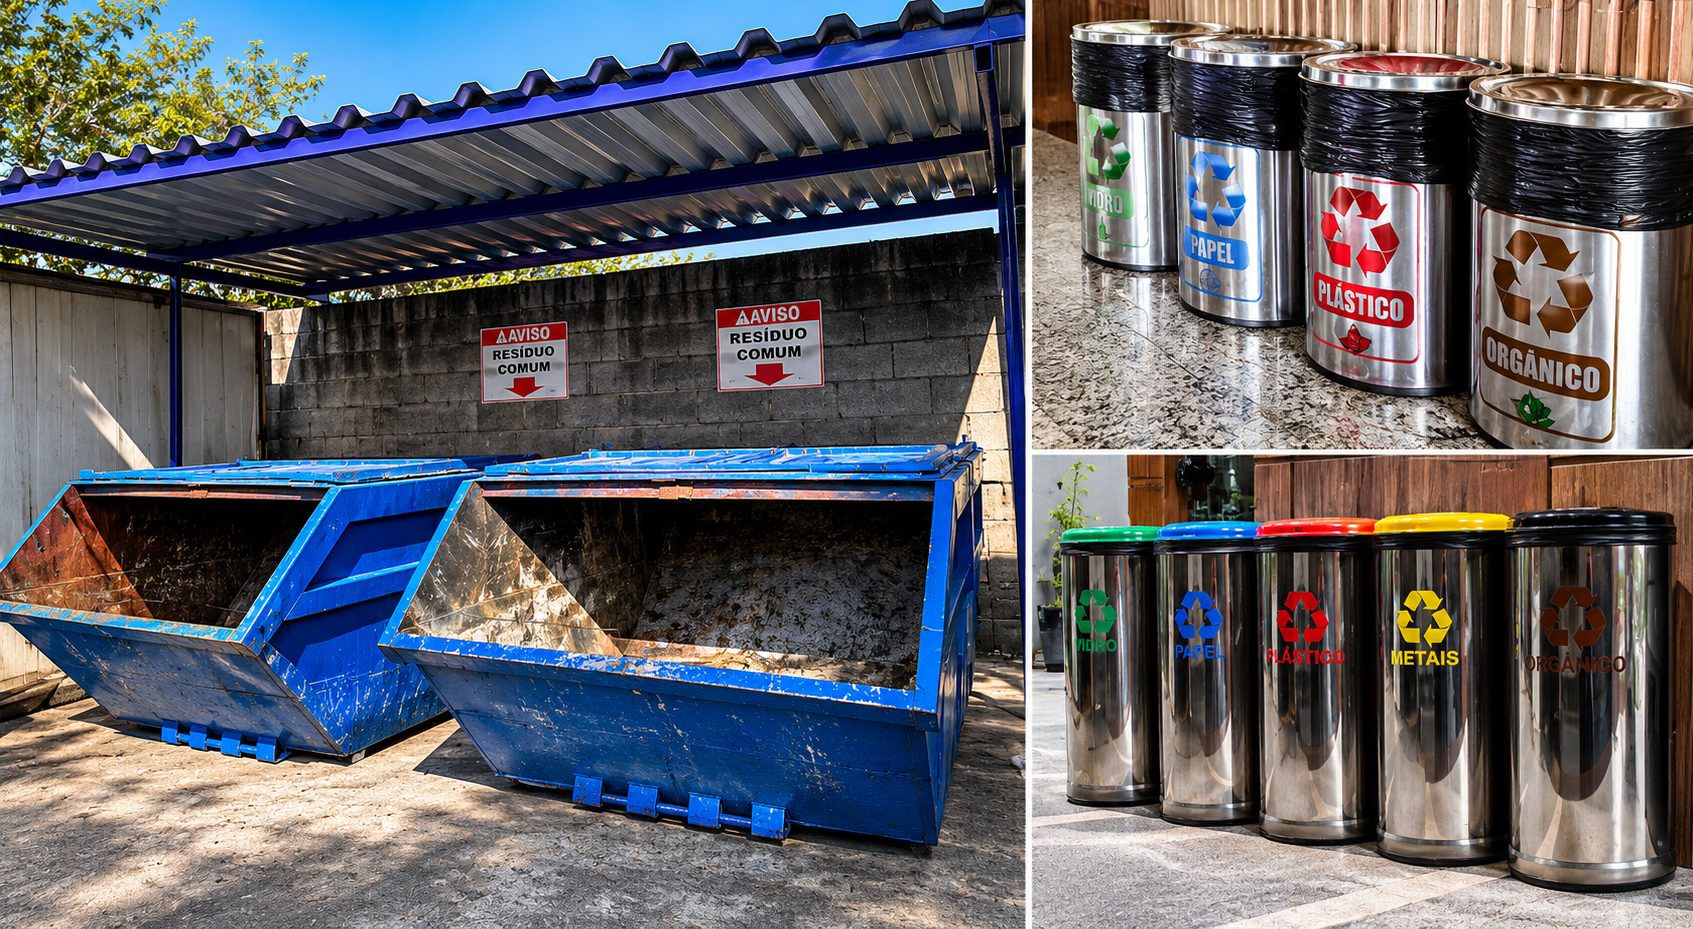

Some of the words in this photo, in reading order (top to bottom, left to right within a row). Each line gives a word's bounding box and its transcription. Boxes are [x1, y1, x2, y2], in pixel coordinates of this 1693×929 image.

[1087, 188, 1124, 214] VIDRO
[1190, 233, 1234, 264] PAPEL
[1318, 279, 1404, 322] PLÁSTICO
[750, 305, 800, 324] AVISO
[508, 326, 550, 342] AVISO
[729, 327, 807, 344] RESÍDUO
[492, 345, 554, 360] RESÍDUO
[736, 345, 801, 361] COMUM
[497, 361, 550, 375] COMUM
[1074, 638, 1118, 652] VIDRO
[1175, 644, 1227, 660] PAPEL
[1266, 645, 1345, 665] PLÁSTICO
[1391, 650, 1459, 666] METAIS
